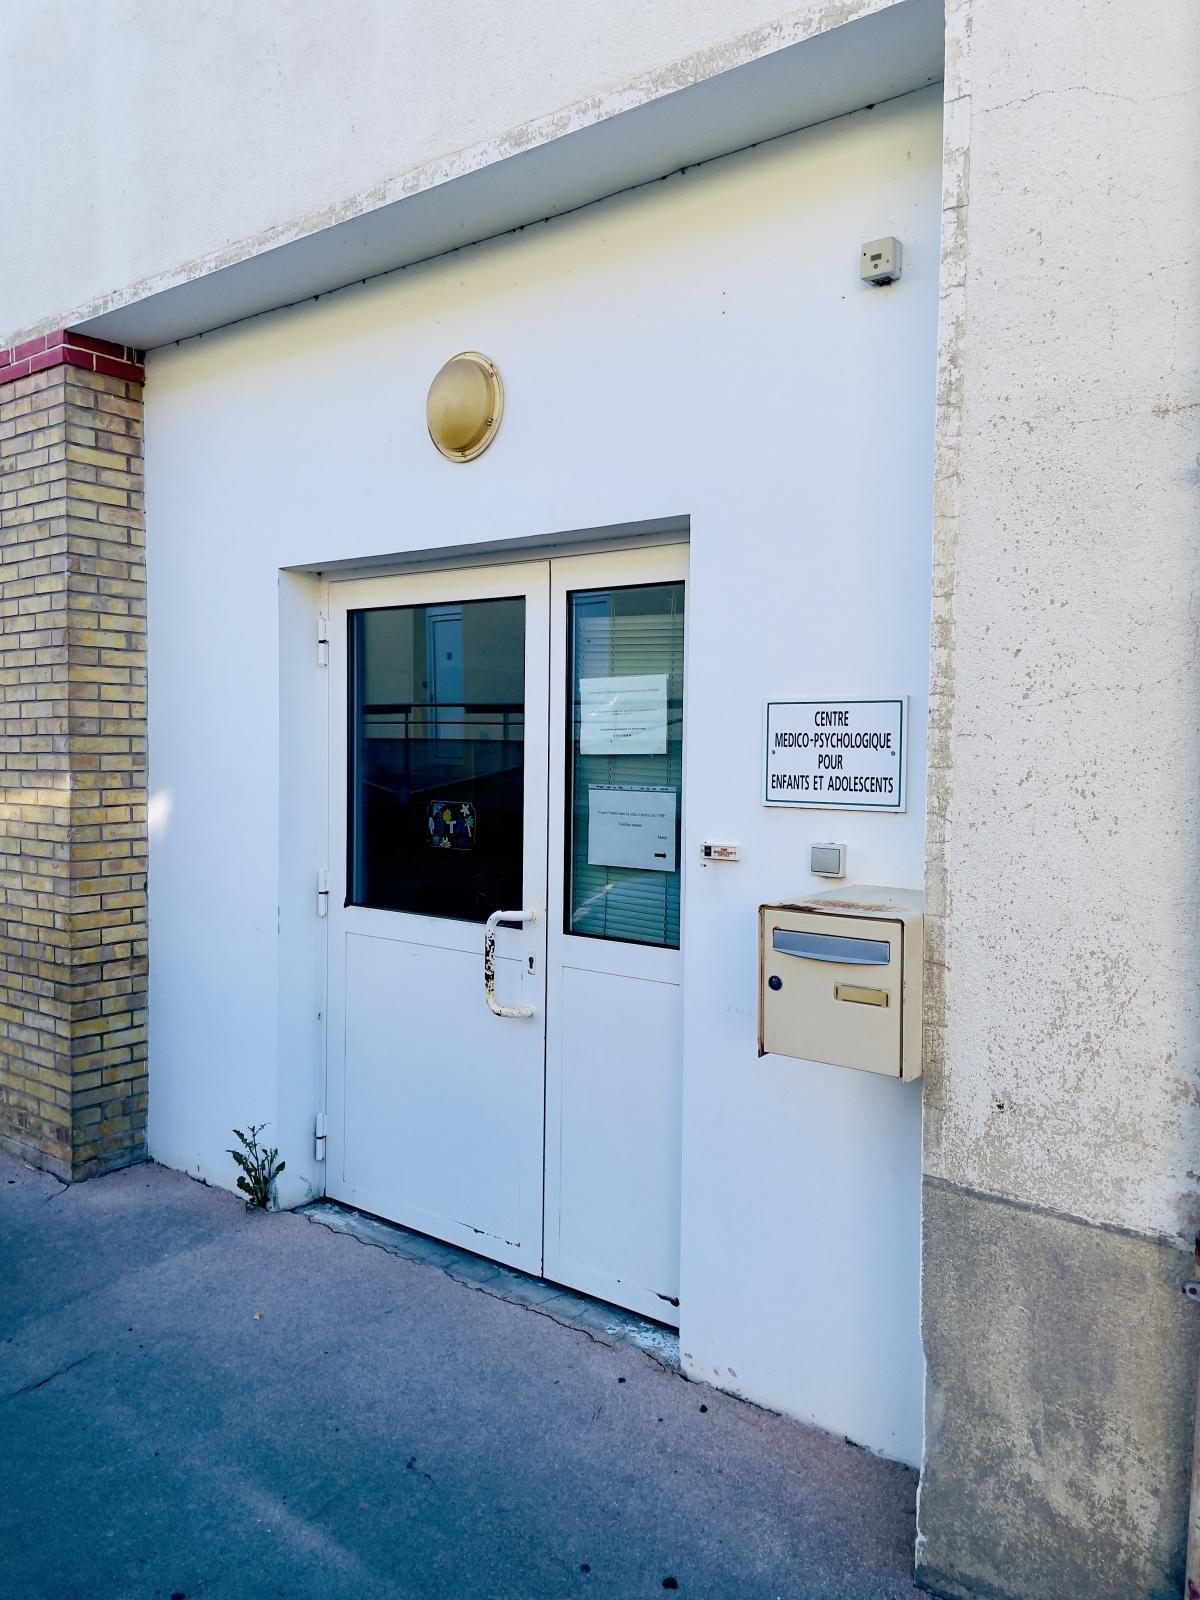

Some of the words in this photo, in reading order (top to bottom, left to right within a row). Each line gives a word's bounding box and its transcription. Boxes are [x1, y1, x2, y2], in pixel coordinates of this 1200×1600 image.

[814, 711, 849, 727] CENTRE
[774, 732, 892, 751] MEDICO-PSYCHOLOGIQUE
[818, 754, 843, 770] POUR
[771, 774, 810, 790] ENFANTS
[813, 775, 824, 791] ET
[827, 776, 894, 793] ADOLESCENTS
